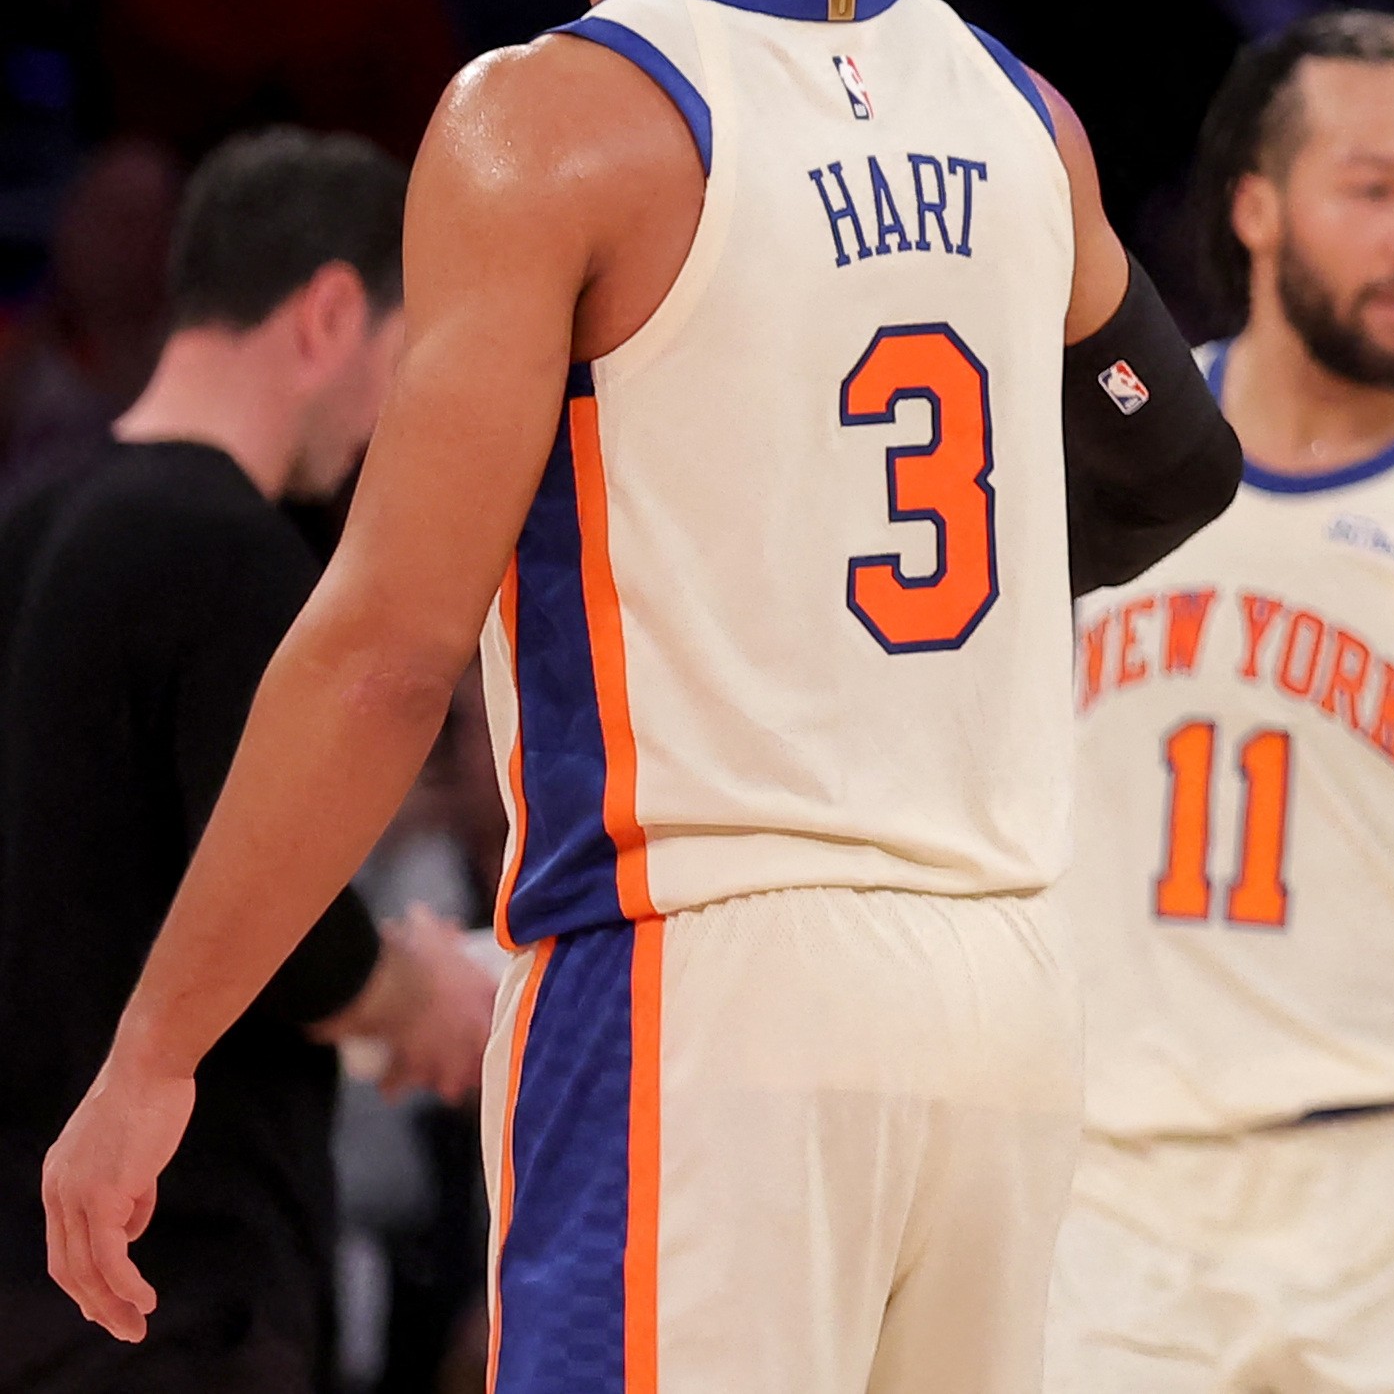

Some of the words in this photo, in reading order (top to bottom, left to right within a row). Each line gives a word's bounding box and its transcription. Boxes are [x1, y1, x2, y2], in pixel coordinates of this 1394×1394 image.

[809, 152, 987, 267] HART
[840, 322, 1000, 655] 3
[1152, 719, 1292, 928] 11
